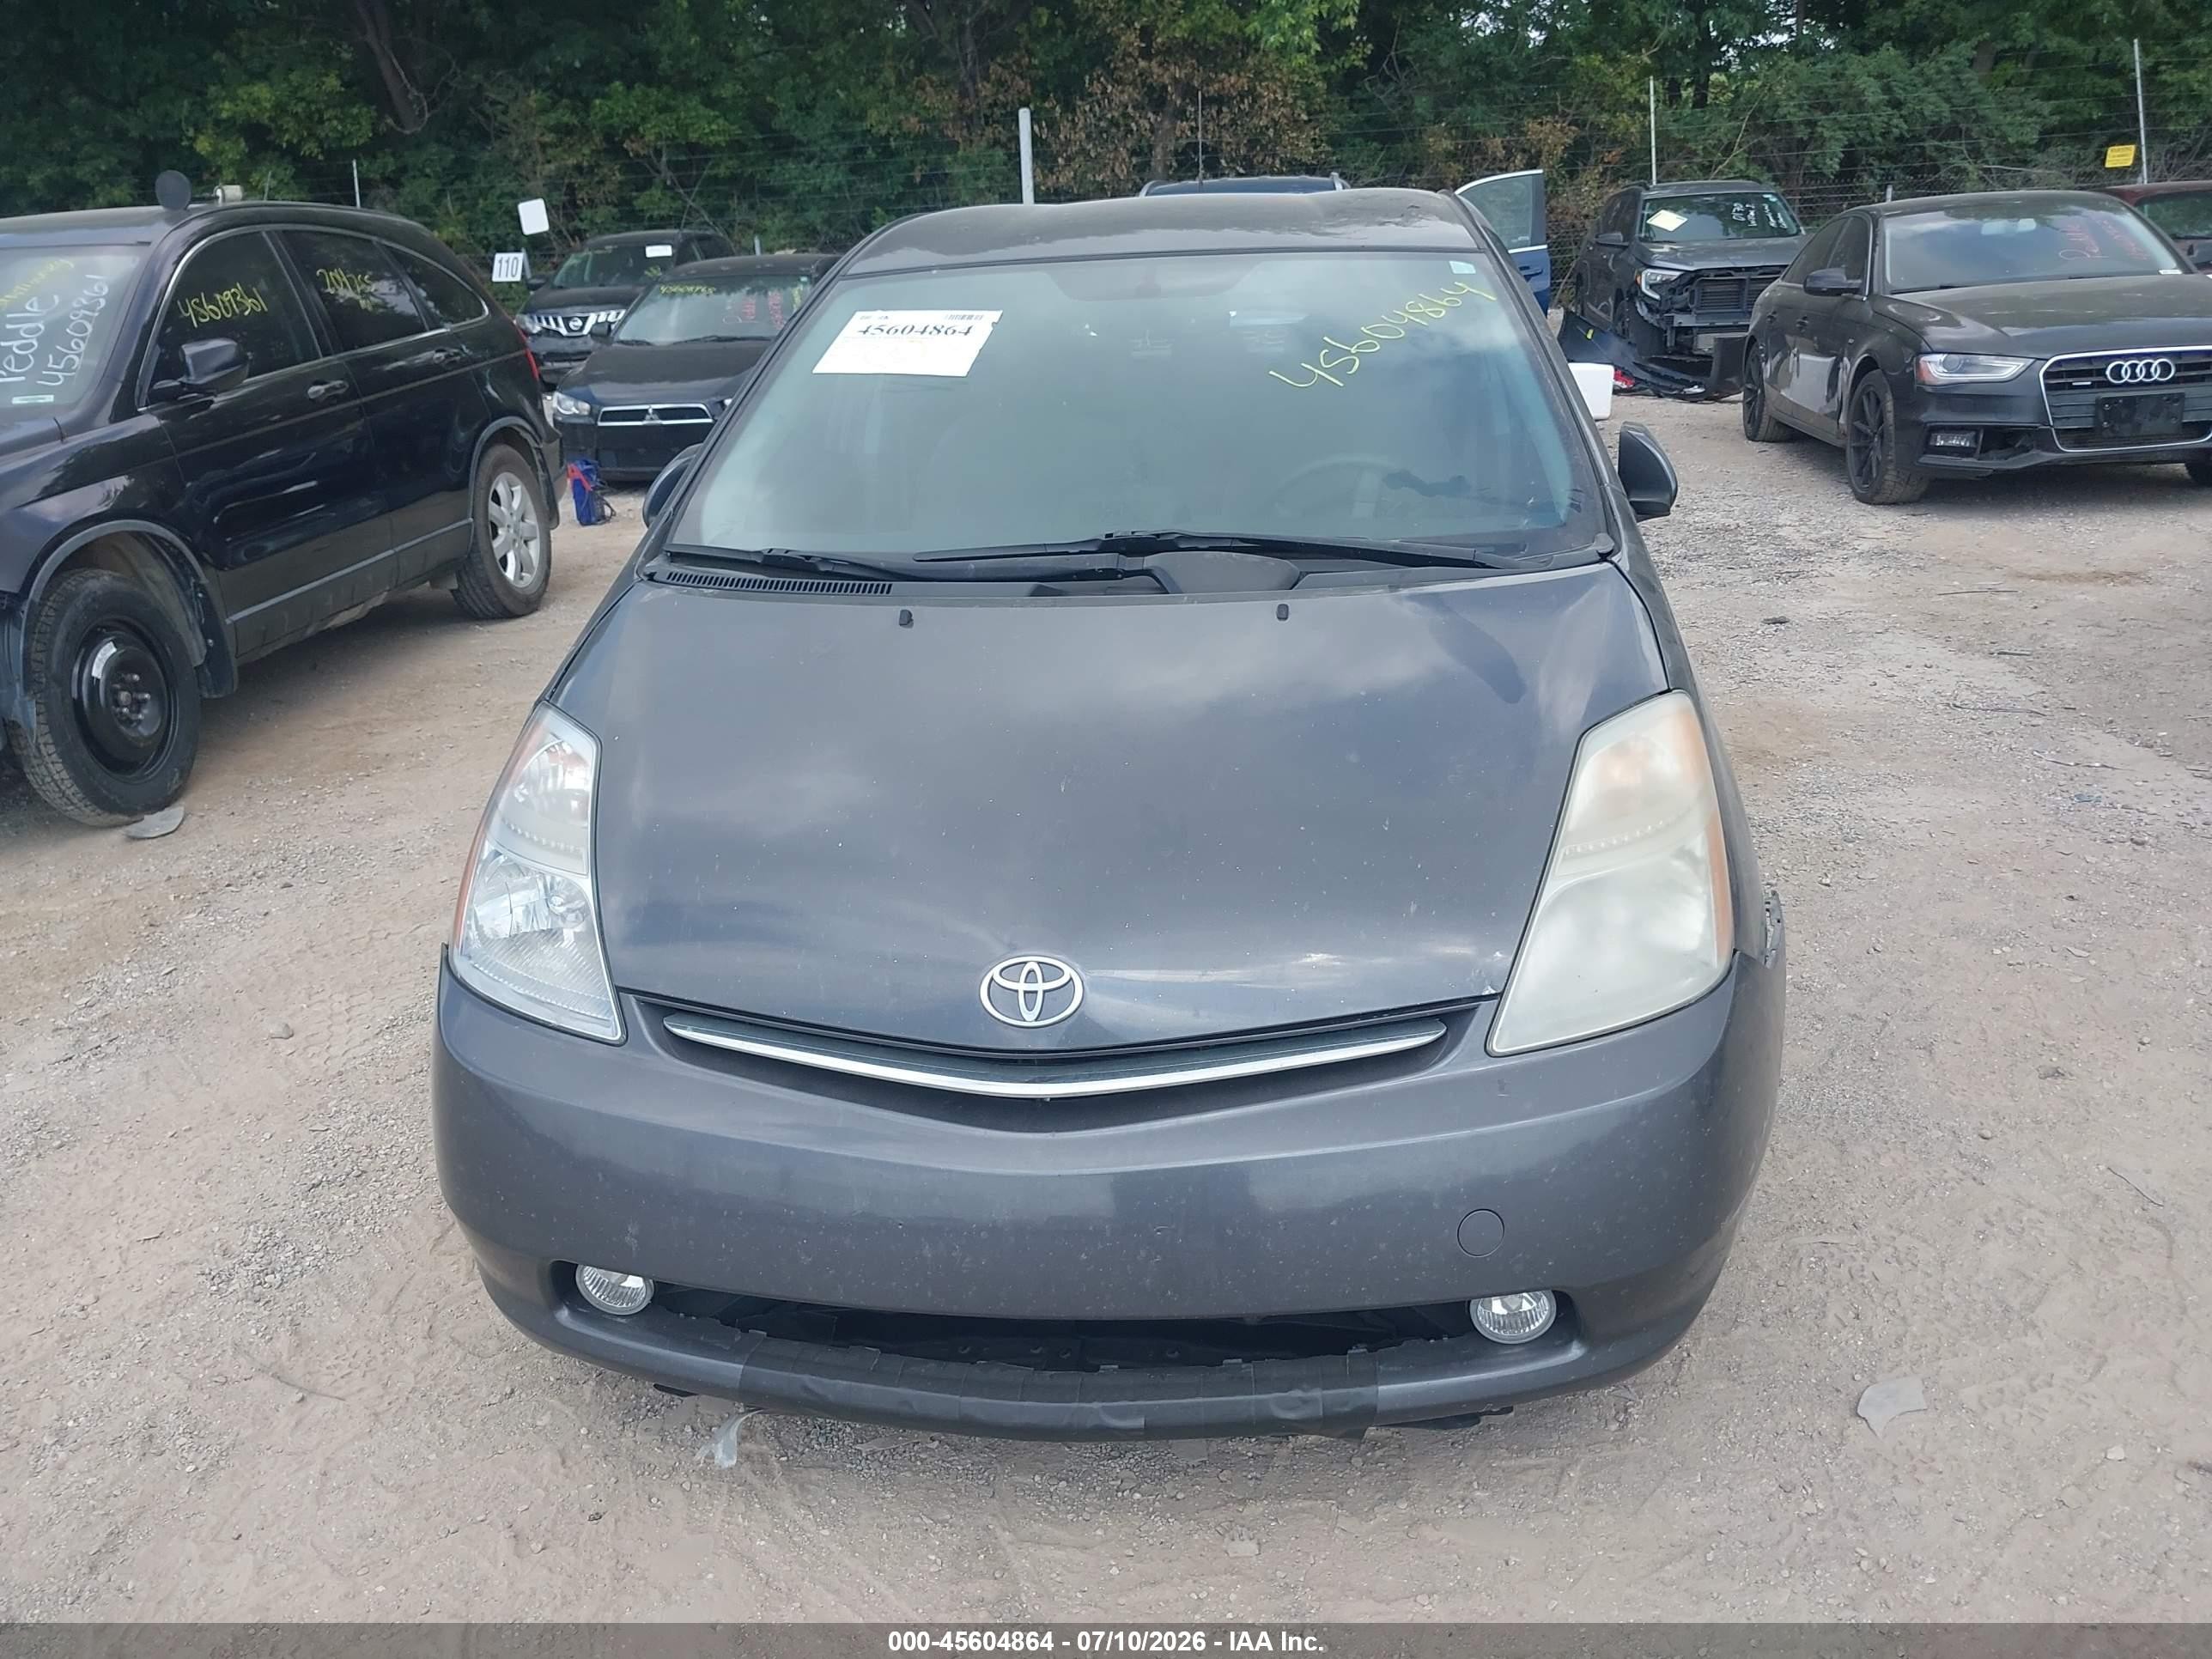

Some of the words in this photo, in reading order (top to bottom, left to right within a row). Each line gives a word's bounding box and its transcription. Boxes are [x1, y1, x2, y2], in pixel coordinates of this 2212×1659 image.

[498, 258, 519, 277] 110
[177, 282, 268, 328] 45609361
[36, 274, 109, 386] 45609361
[858, 324, 974, 336] 45604864
[1268, 281, 1498, 388] 45604864
